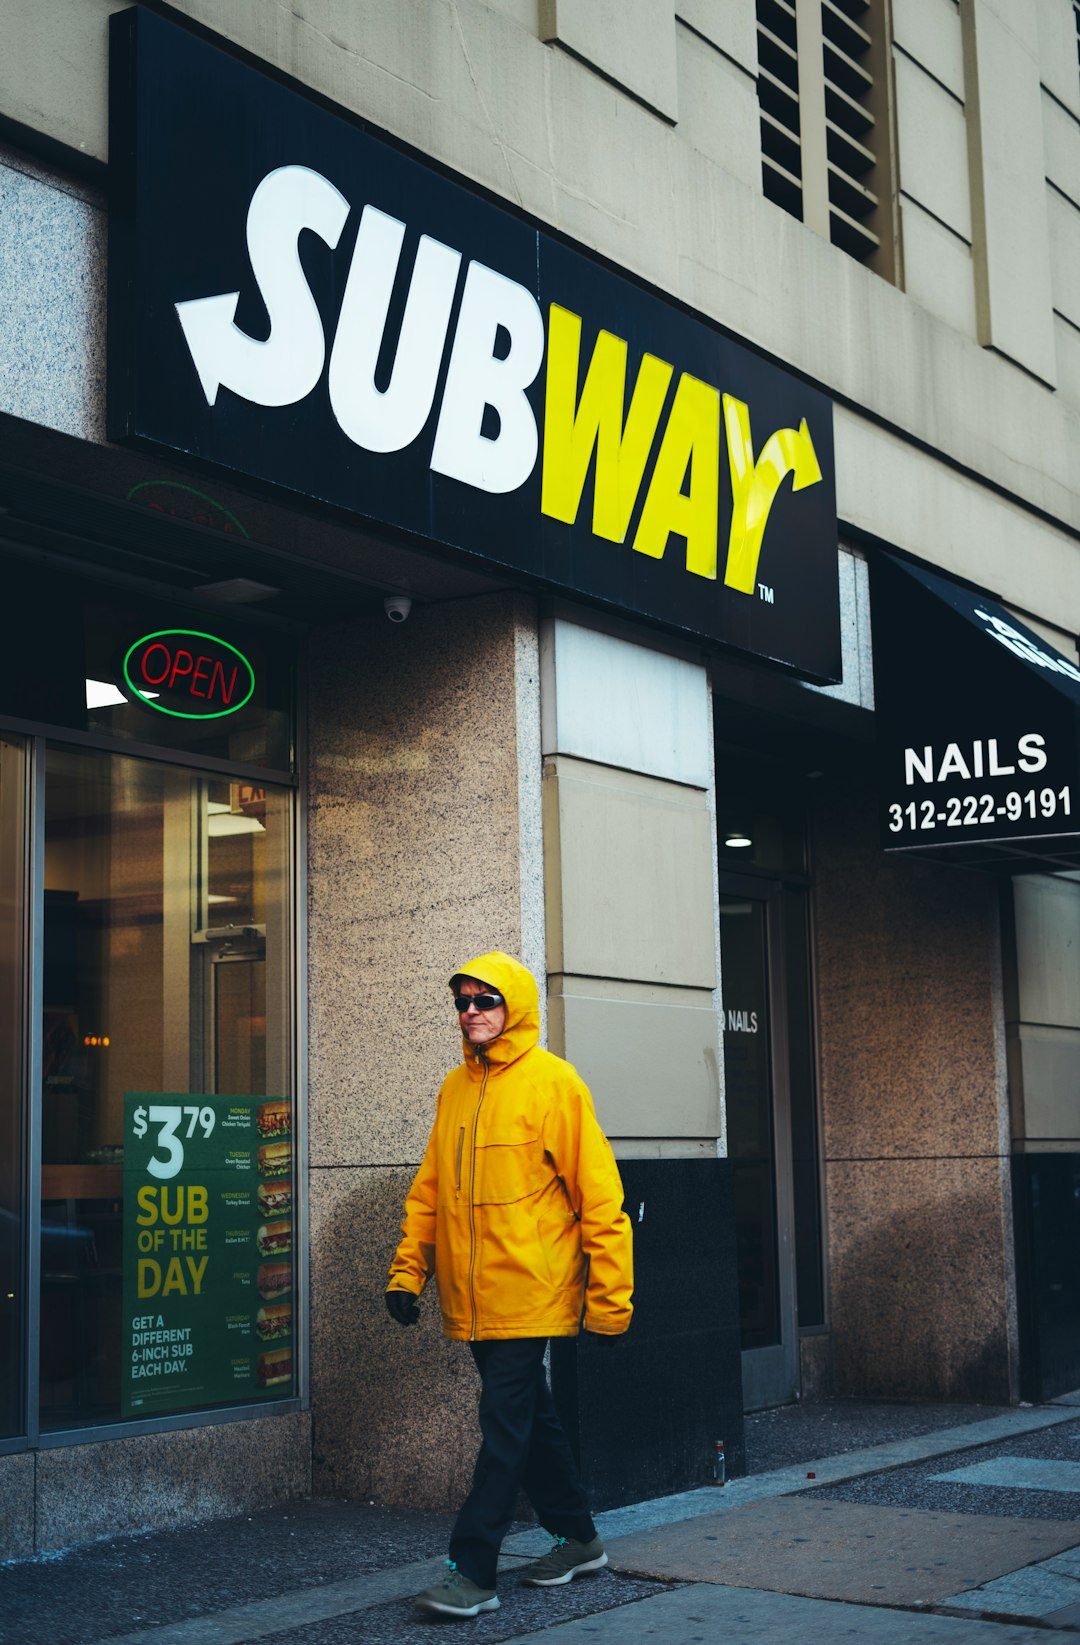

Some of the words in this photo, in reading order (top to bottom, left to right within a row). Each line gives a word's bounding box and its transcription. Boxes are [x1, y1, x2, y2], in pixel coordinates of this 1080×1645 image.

[174, 164, 823, 596] SUBWAY
[758, 583, 775, 604] TM
[141, 643, 238, 705] OPEN
[904, 732, 1048, 786] NAILS
[888, 785, 1072, 833] 312-222-9191
[728, 1009, 758, 1034] NAILS
[136, 1185, 208, 1226] SUB
[137, 1229, 165, 1253] OF
[170, 1228, 208, 1251] THE
[137, 1255, 209, 1299] DAY
[132, 1315, 154, 1330] GET
[156, 1314, 165, 1327] A
[132, 1327, 192, 1347] DIFFERENT
[131, 1345, 169, 1362] 6-INCH
[171, 1343, 193, 1358] SUB
[131, 1362, 161, 1379] EACH
[164, 1359, 188, 1374] DAY.
